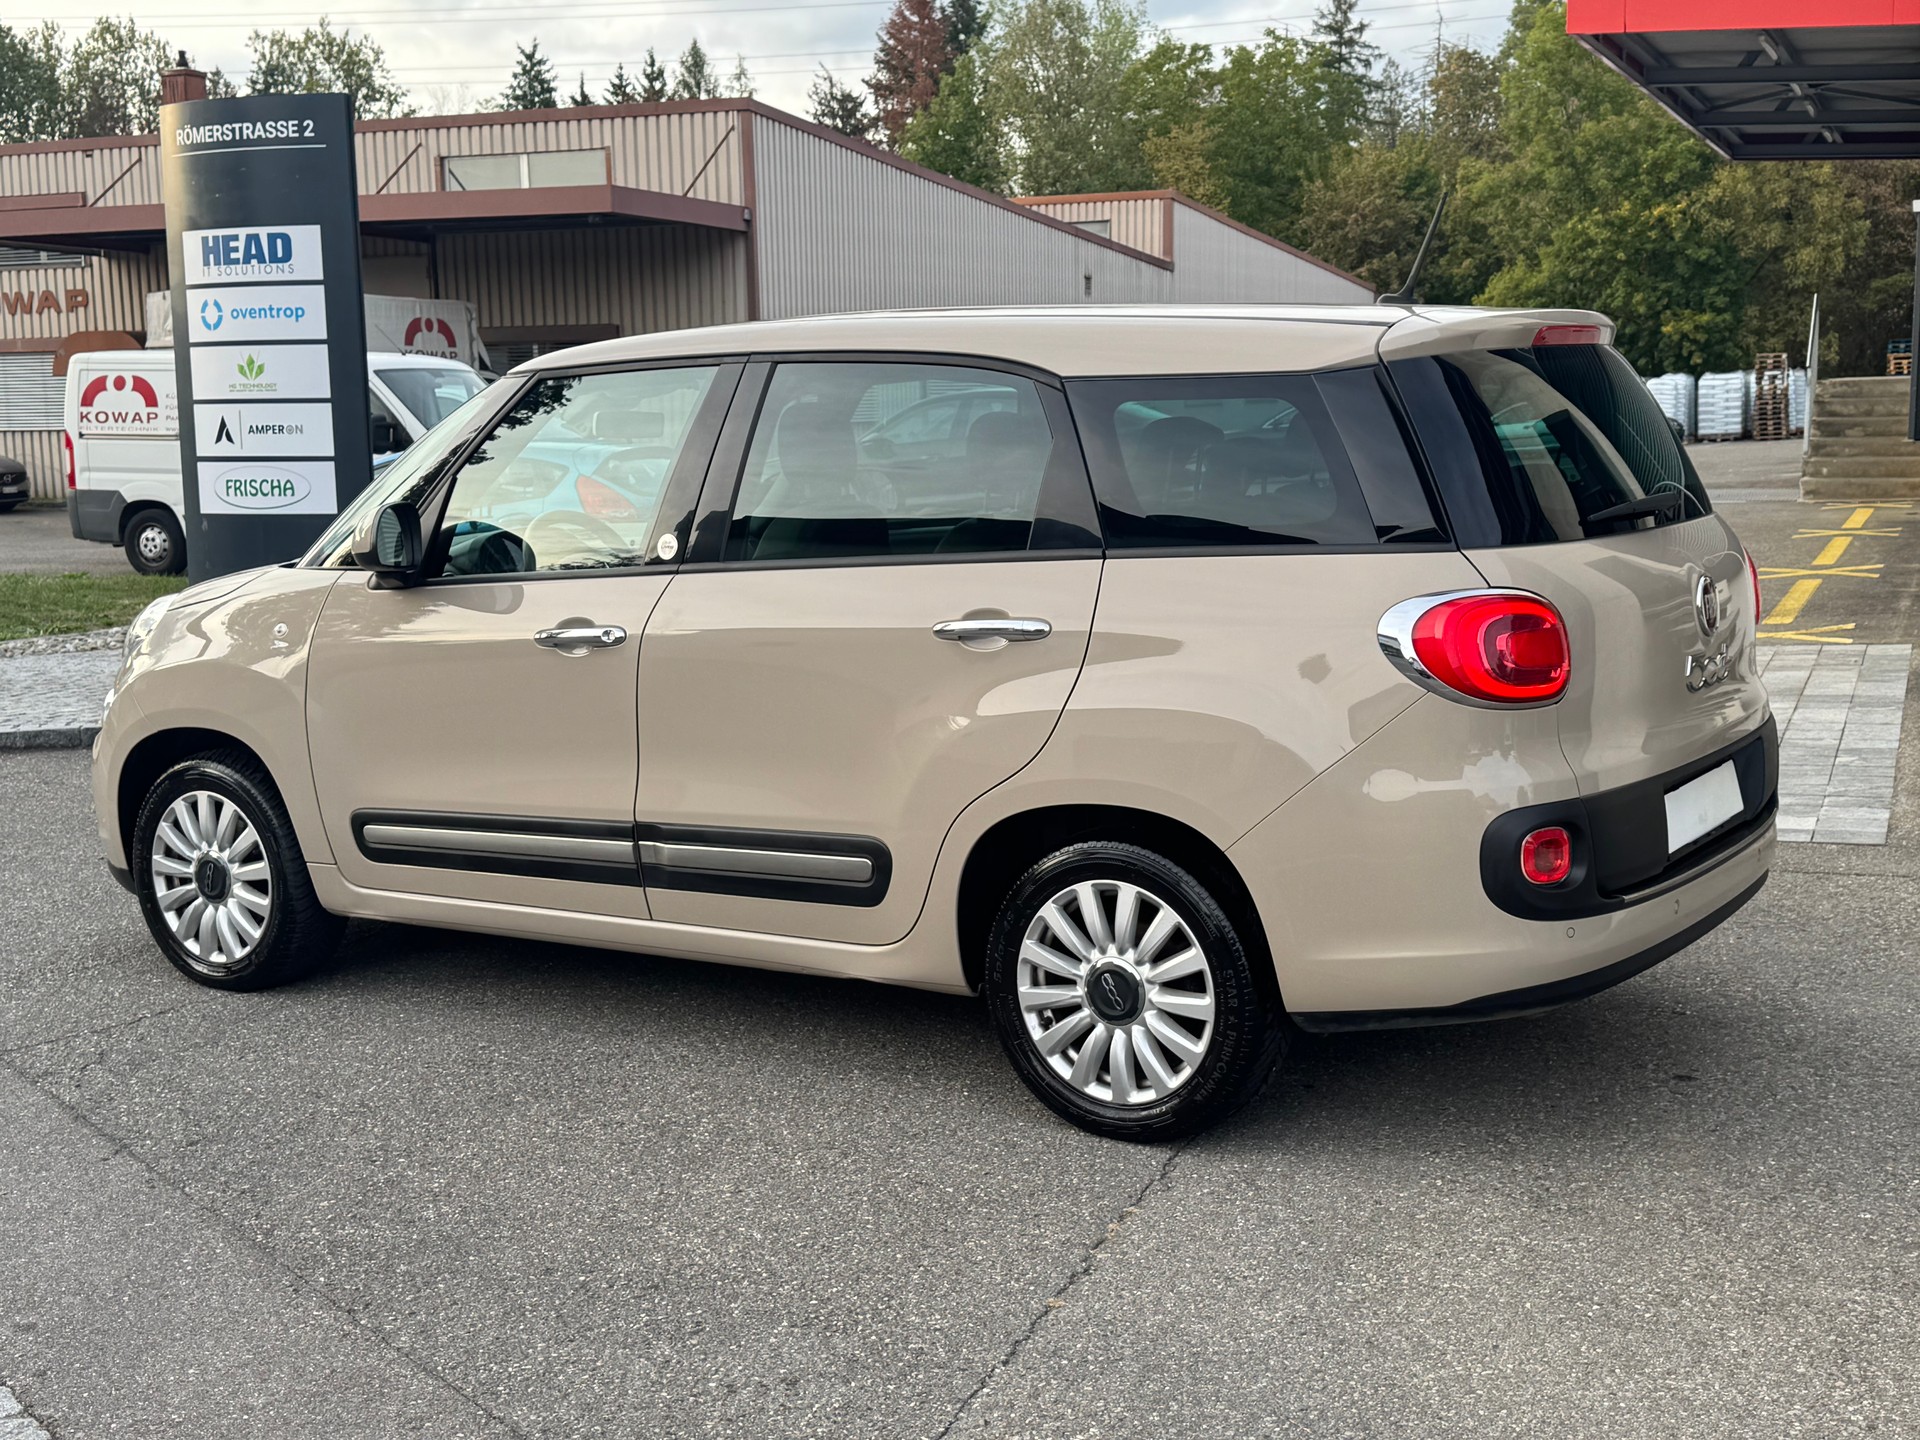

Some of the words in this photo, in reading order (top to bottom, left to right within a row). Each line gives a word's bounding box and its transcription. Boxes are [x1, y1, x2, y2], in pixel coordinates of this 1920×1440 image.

[176, 120, 299, 146] RÖMERSTRASSE
[302, 119, 315, 137] 2
[201, 232, 292, 267] HEAD
[202, 266, 211, 277] IT
[217, 263, 295, 277] SOLUTIONS
[2, 289, 88, 316] WAP
[230, 304, 305, 322] oventrop
[80, 411, 158, 424] KOWAP
[248, 424, 303, 435] AMPERON
[225, 479, 295, 497] FRISCHA
